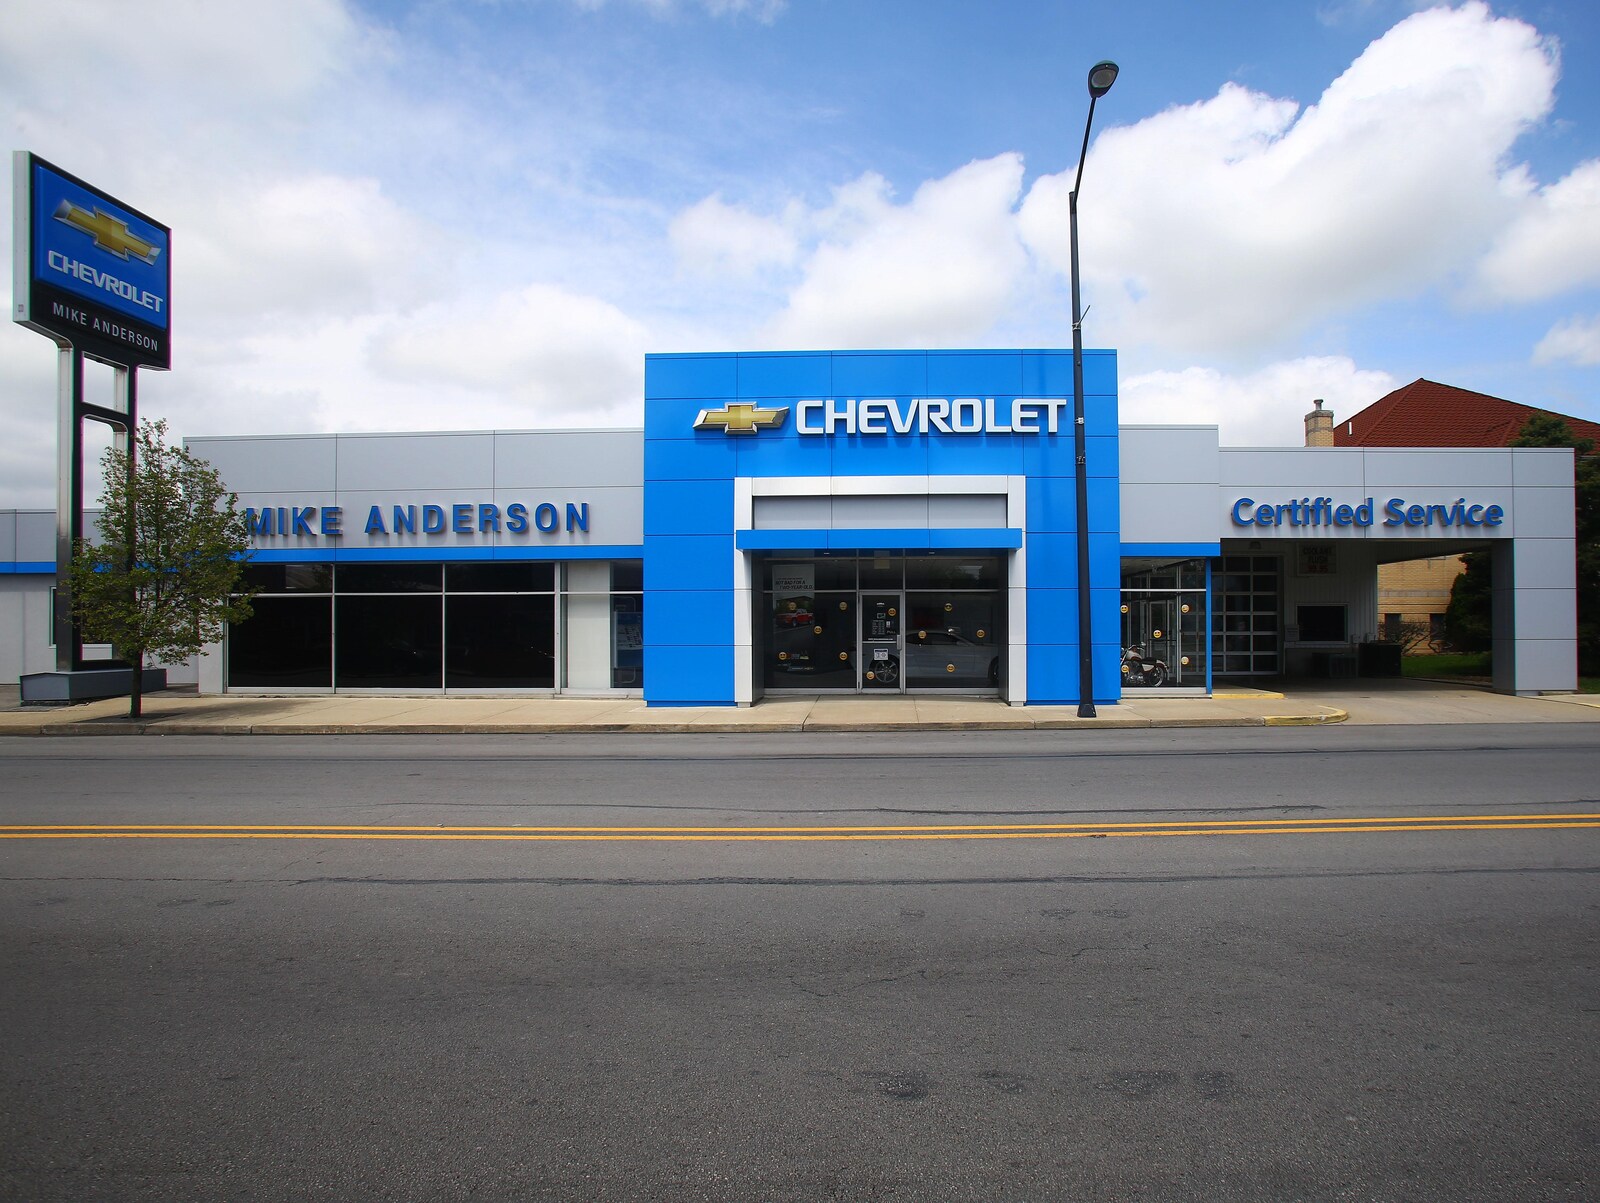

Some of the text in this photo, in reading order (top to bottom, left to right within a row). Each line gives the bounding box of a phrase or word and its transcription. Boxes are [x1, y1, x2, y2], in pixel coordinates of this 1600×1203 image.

[48, 250, 164, 313] CHEVROLET
[52, 301, 158, 352] MIKE ANDERSON
[796, 398, 1067, 434] CHEVROLET
[246, 502, 591, 536] MIKE ANDERSON
[1231, 497, 1504, 526] Certified Service
